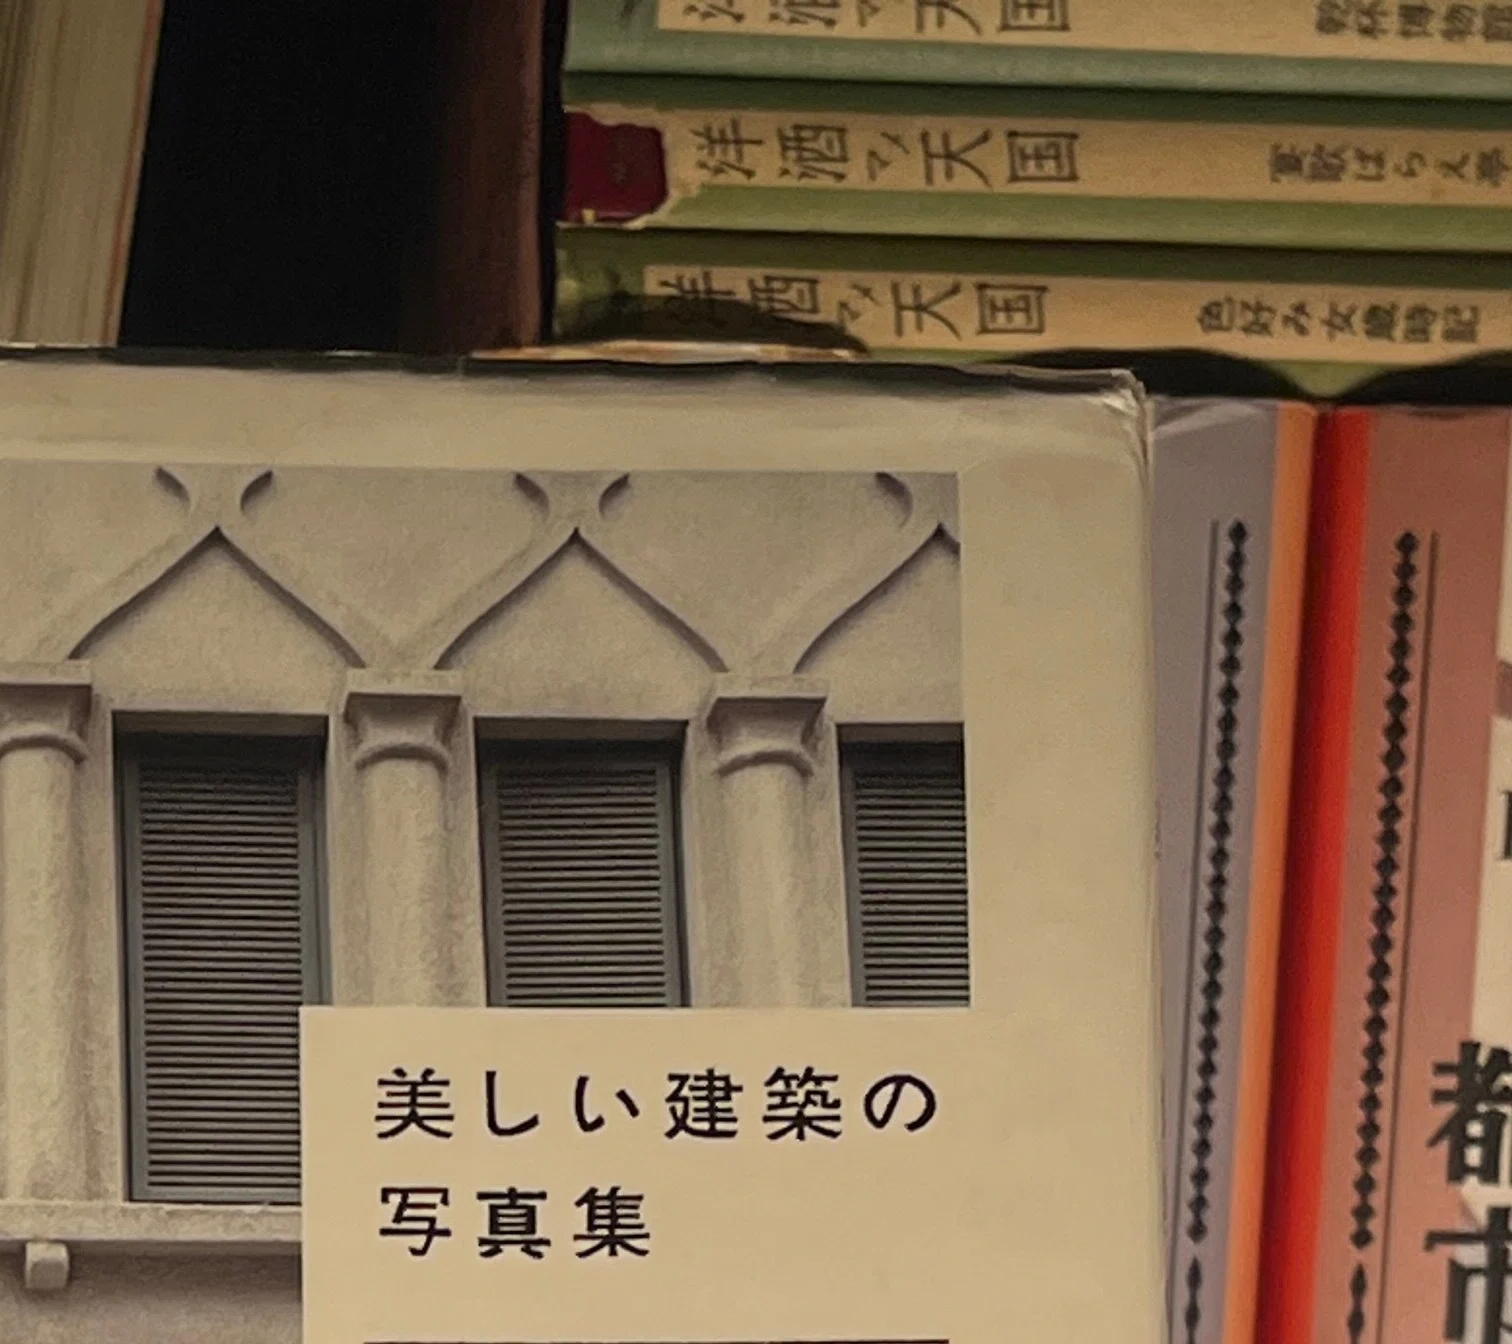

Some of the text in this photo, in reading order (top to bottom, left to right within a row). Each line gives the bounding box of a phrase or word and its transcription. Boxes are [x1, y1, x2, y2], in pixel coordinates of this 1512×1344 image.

[374, 1065, 937, 1142] 美しい建築の
[378, 1185, 651, 1260] 写真集
